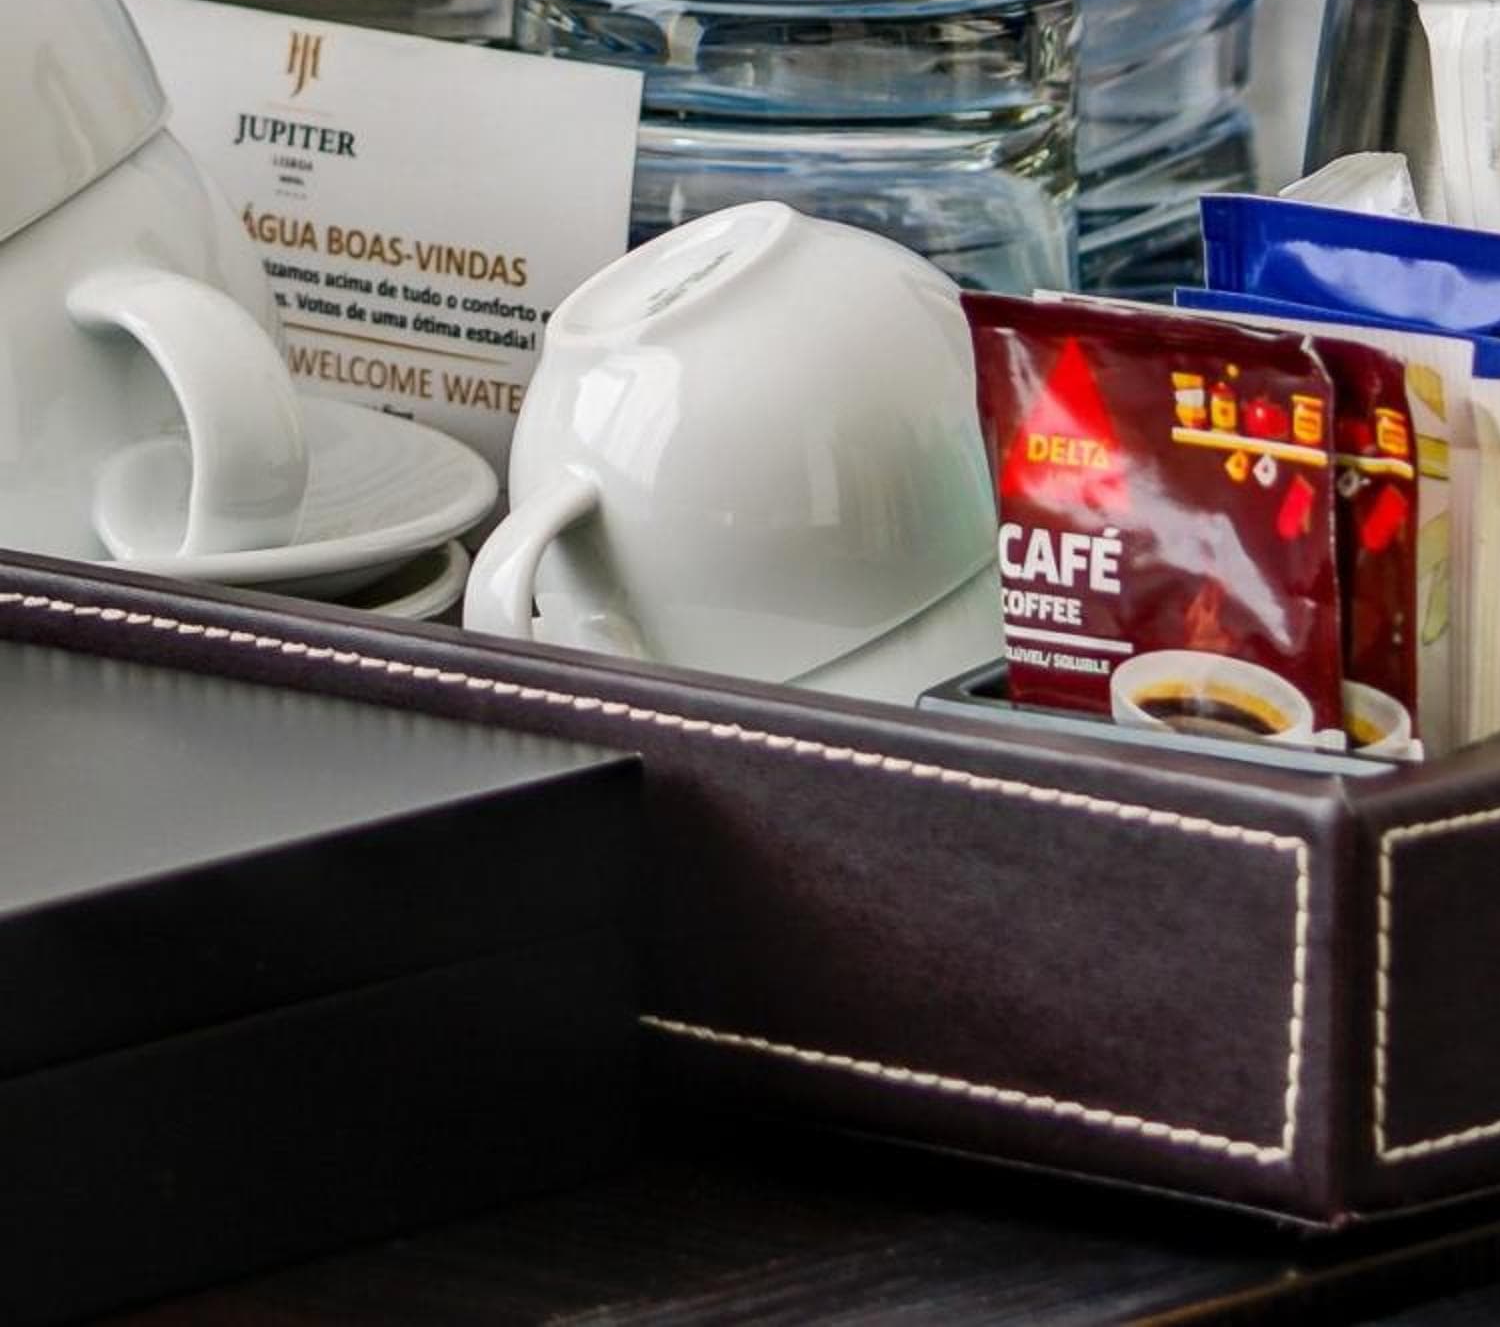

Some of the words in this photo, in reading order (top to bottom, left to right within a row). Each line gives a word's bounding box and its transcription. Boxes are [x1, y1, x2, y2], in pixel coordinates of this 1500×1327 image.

[233, 113, 357, 158] JUPITER
[327, 225, 527, 287] BOAS-VINDAS
[296, 290, 342, 318] Votos
[346, 302, 367, 323] de
[371, 311, 408, 330] uma
[412, 313, 462, 339] ótima
[466, 325, 536, 351] estadia!
[325, 272, 372, 294] acima
[377, 279, 398, 299] de
[402, 283, 442, 307] tudo
[447, 294, 458, 310] o
[462, 297, 537, 323] conforto
[288, 343, 434, 400] WELCOME
[442, 370, 522, 414] WATE
[1027, 433, 1111, 470] DELTA
[998, 522, 1122, 594] CAFÉ
